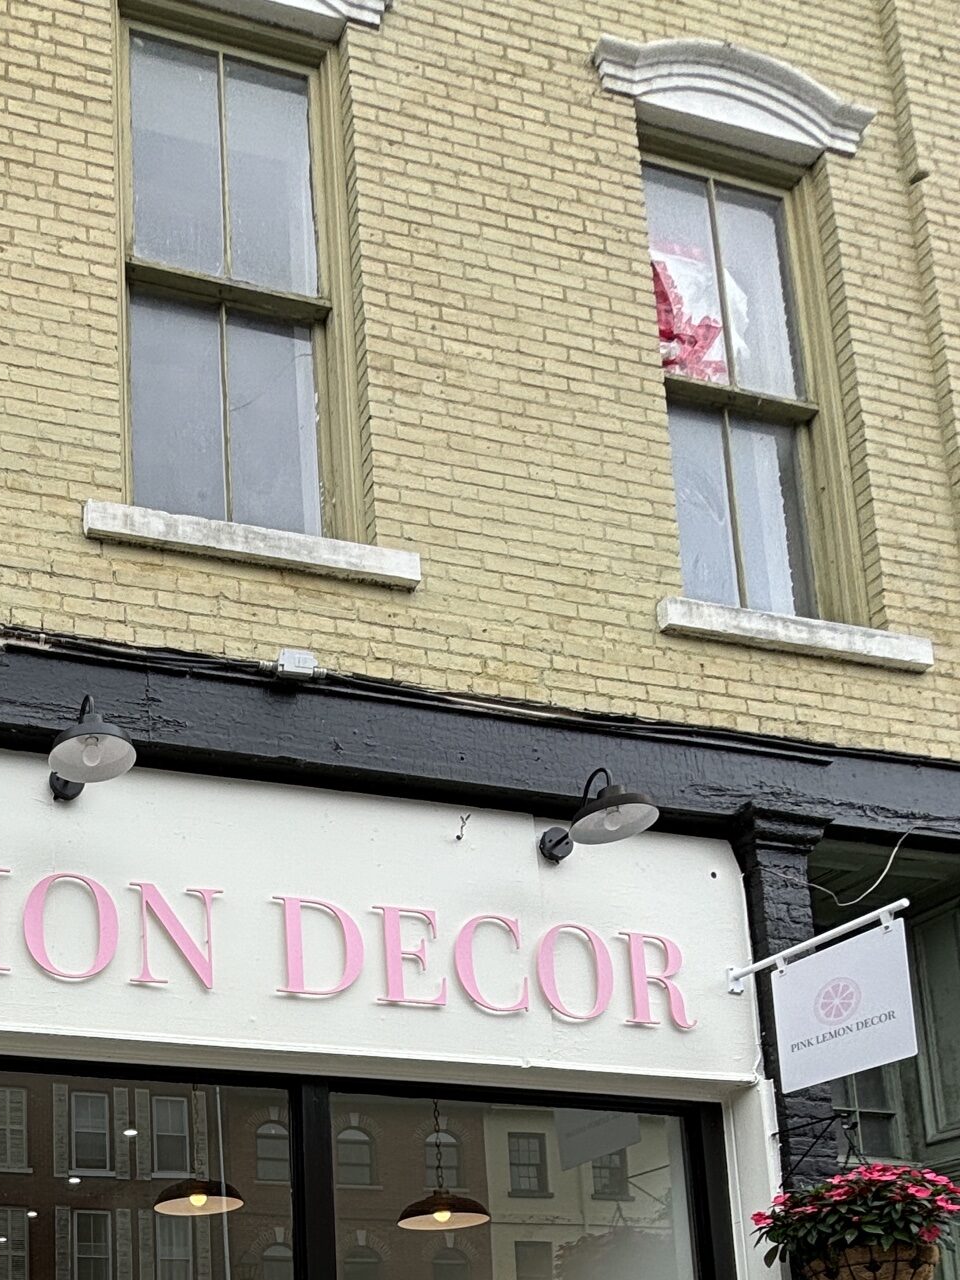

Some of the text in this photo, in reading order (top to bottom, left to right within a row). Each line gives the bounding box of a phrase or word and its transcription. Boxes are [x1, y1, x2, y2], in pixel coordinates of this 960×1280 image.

[271, 894, 699, 1031] DECOR
[790, 1009, 897, 1053] PINK LEMON DECOR
